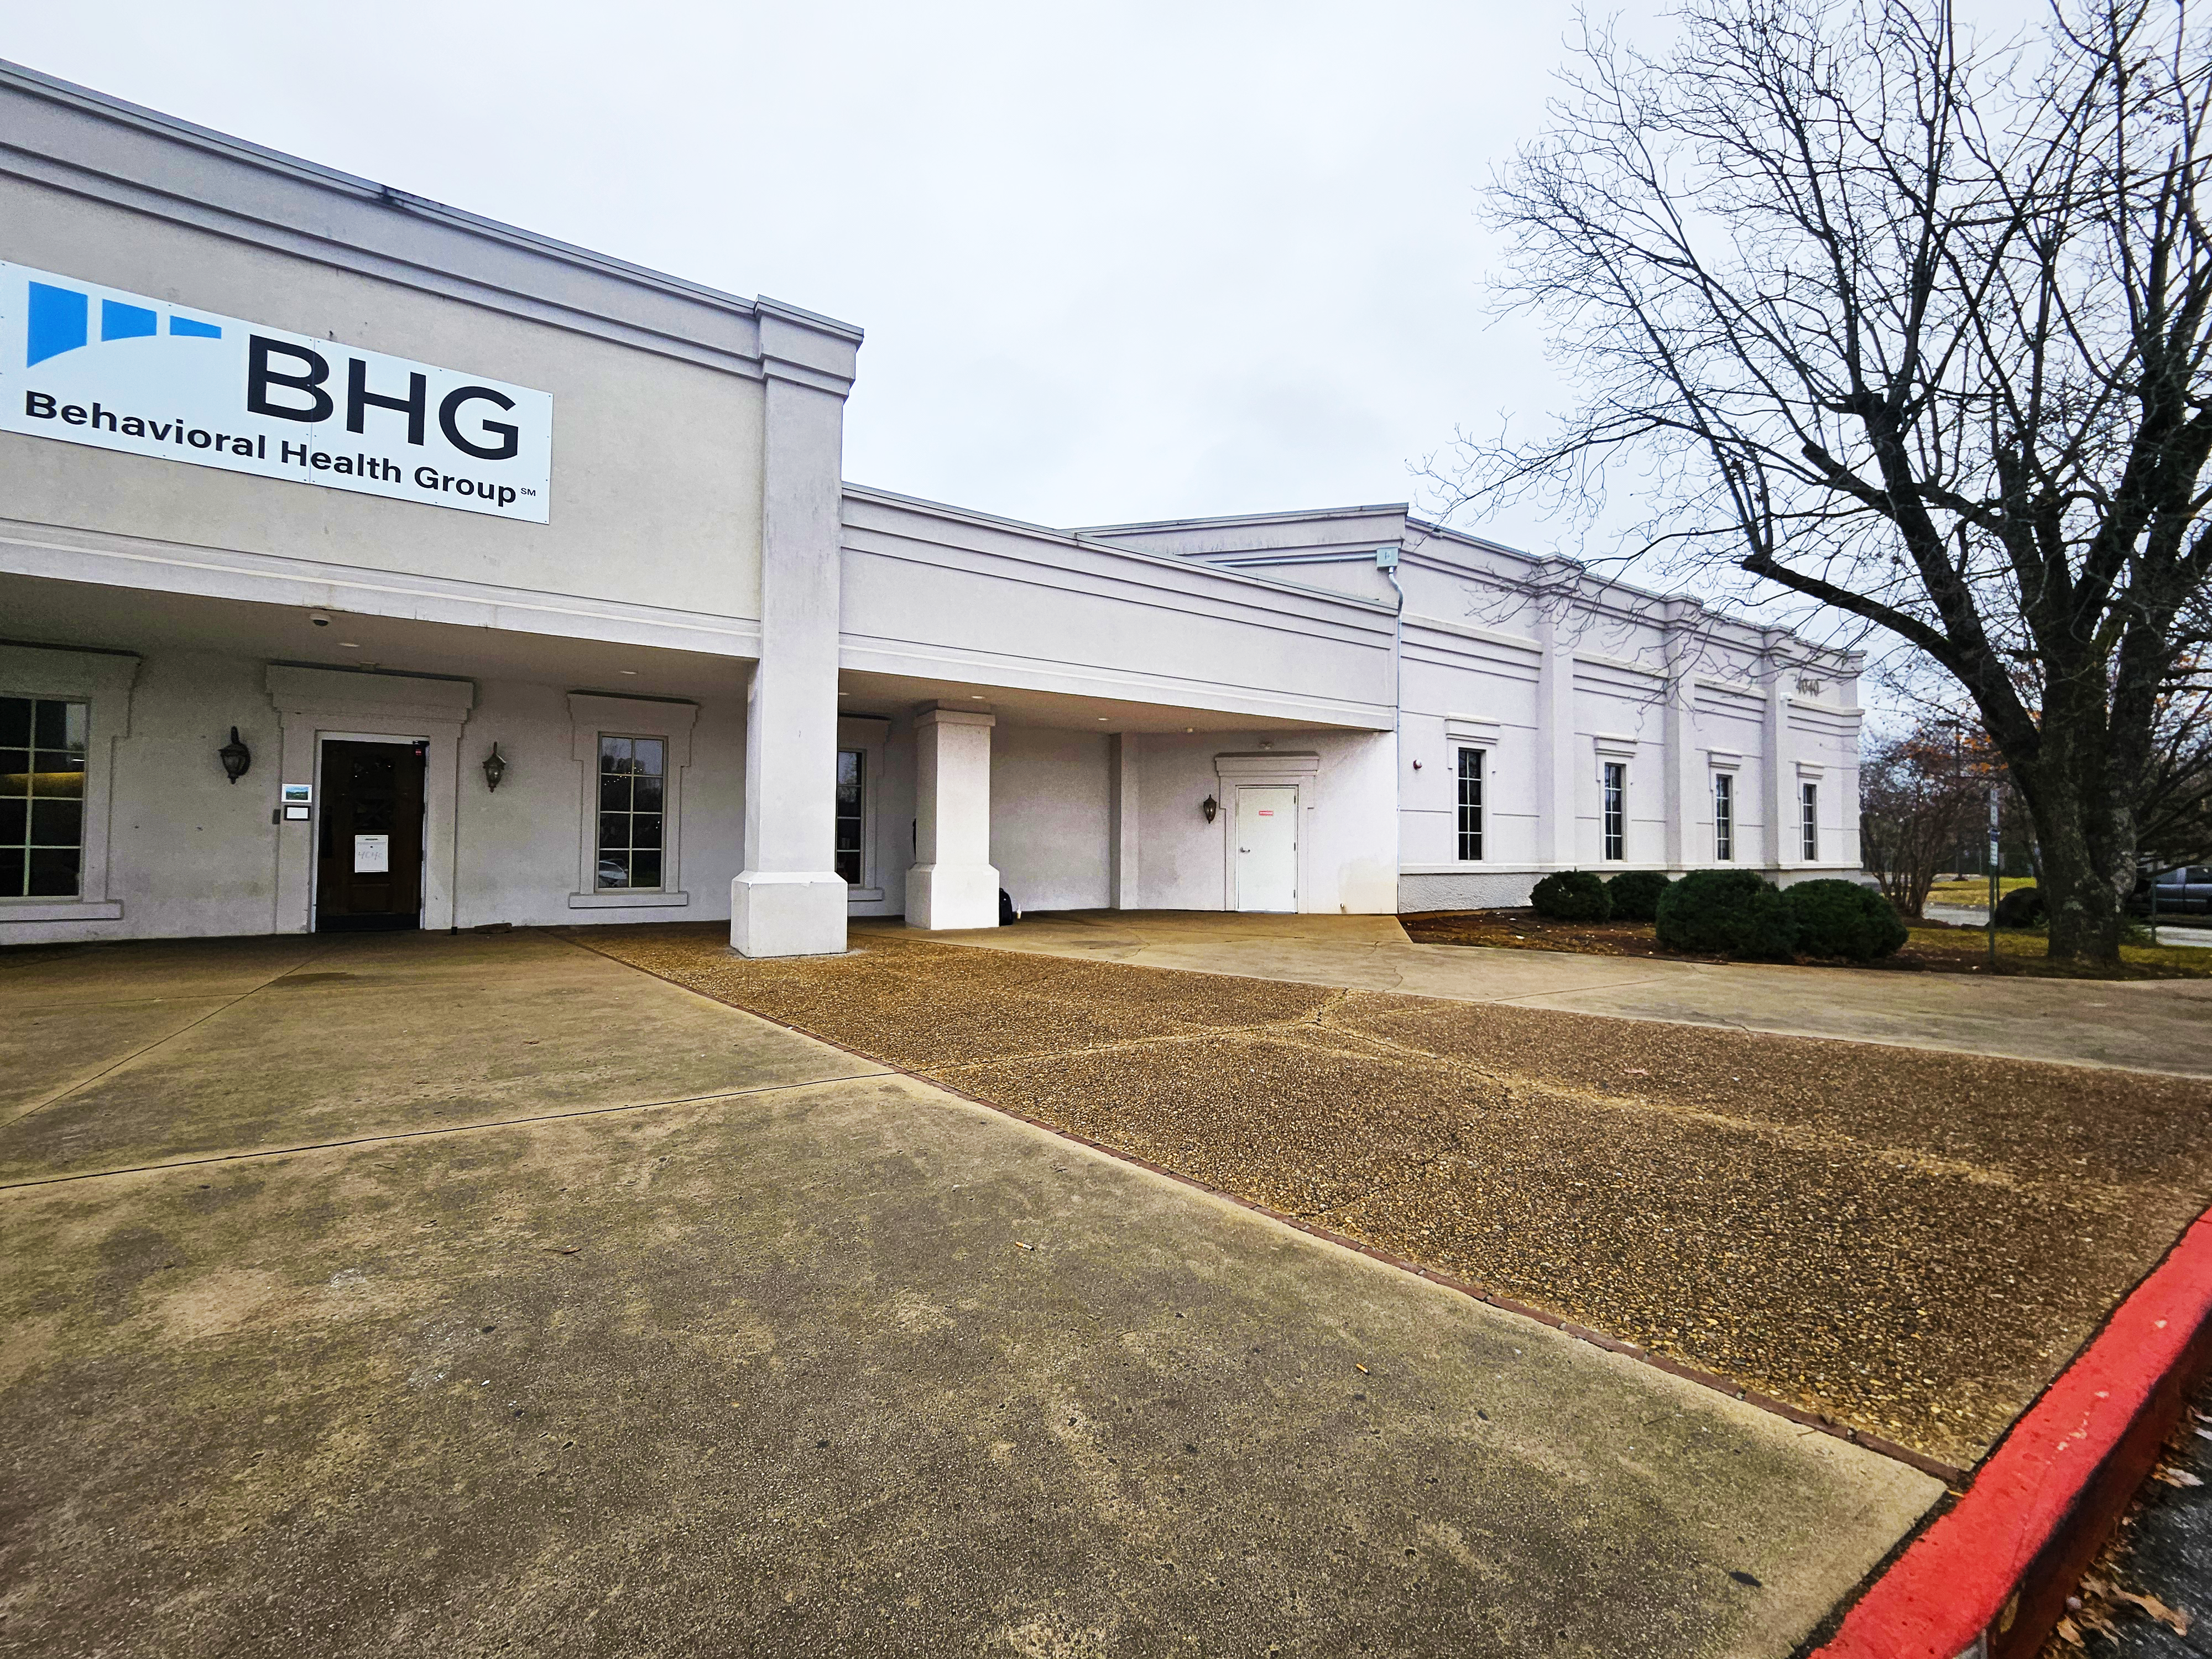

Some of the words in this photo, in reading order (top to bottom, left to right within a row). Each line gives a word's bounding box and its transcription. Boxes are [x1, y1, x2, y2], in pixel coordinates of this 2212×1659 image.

[26, 390, 265, 460] Behavioral
[281, 440, 401, 483] Health
[414, 466, 516, 508] Group
[247, 333, 519, 460] BHG
